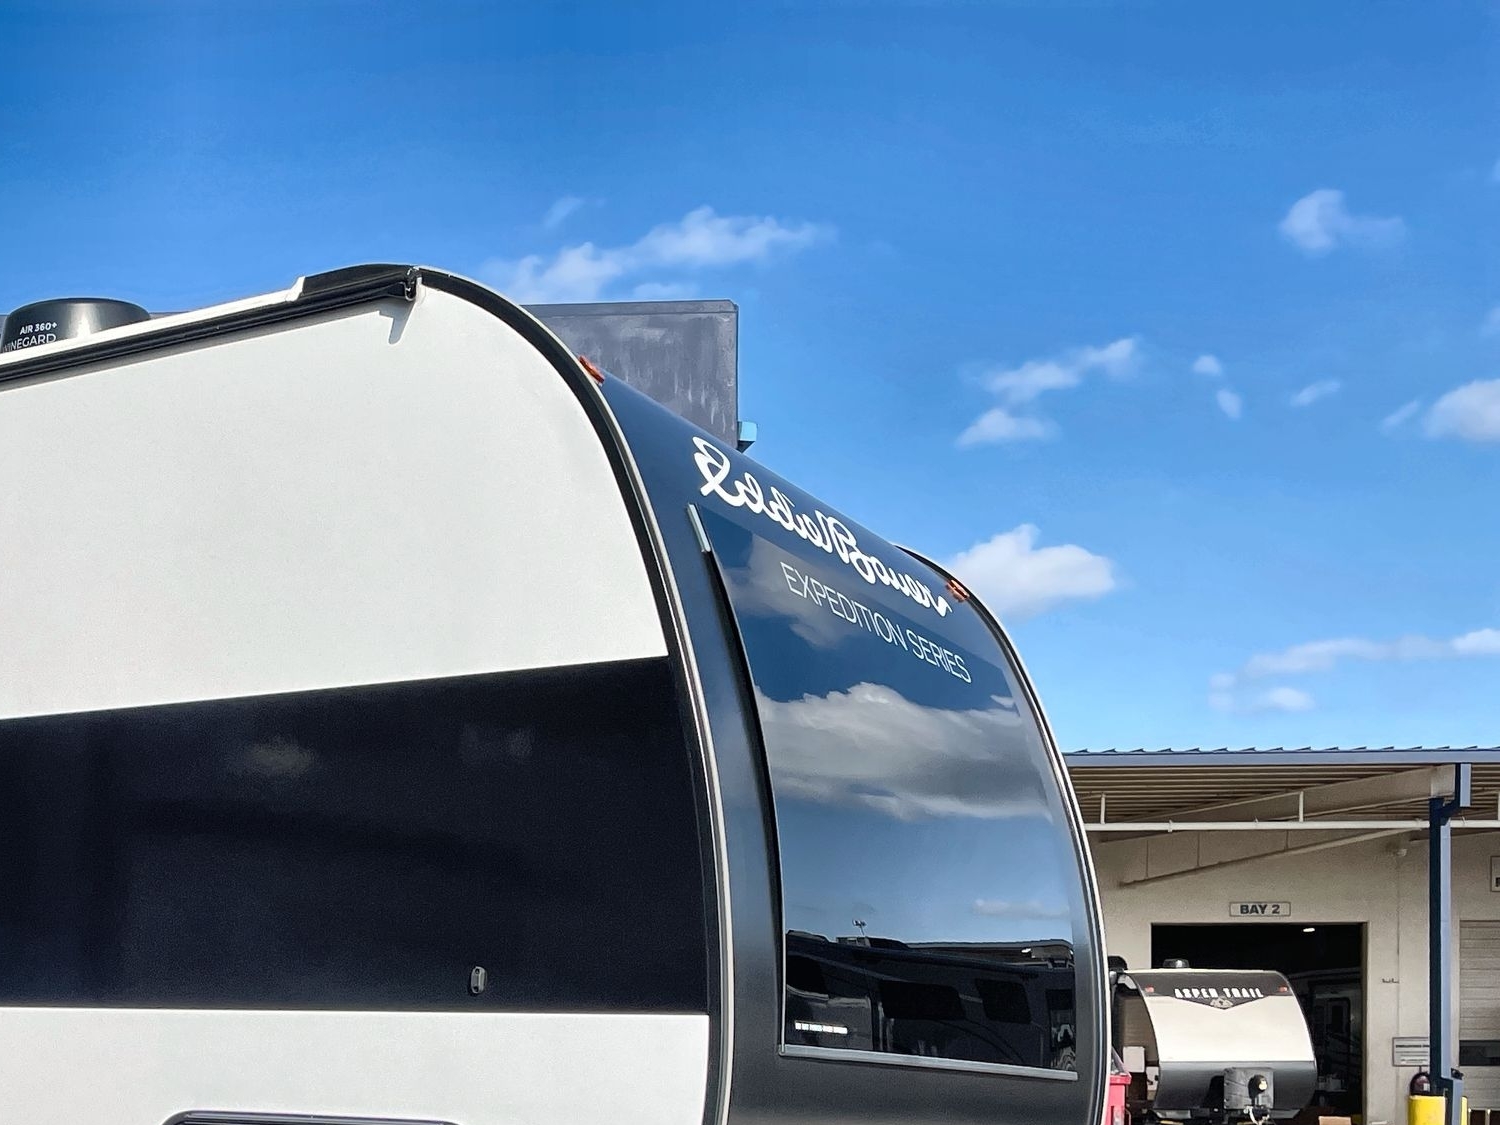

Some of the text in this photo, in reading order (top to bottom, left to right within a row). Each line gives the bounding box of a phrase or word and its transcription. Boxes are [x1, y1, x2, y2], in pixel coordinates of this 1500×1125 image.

[20, 321, 58, 335] AIR 360+
[692, 436, 954, 617] Eddie Bauer
[780, 561, 972, 684] EXPEDITION SERIES
[1240, 904, 1280, 914] BAY 2
[1174, 987, 1264, 998] ASPEN TRAIL
